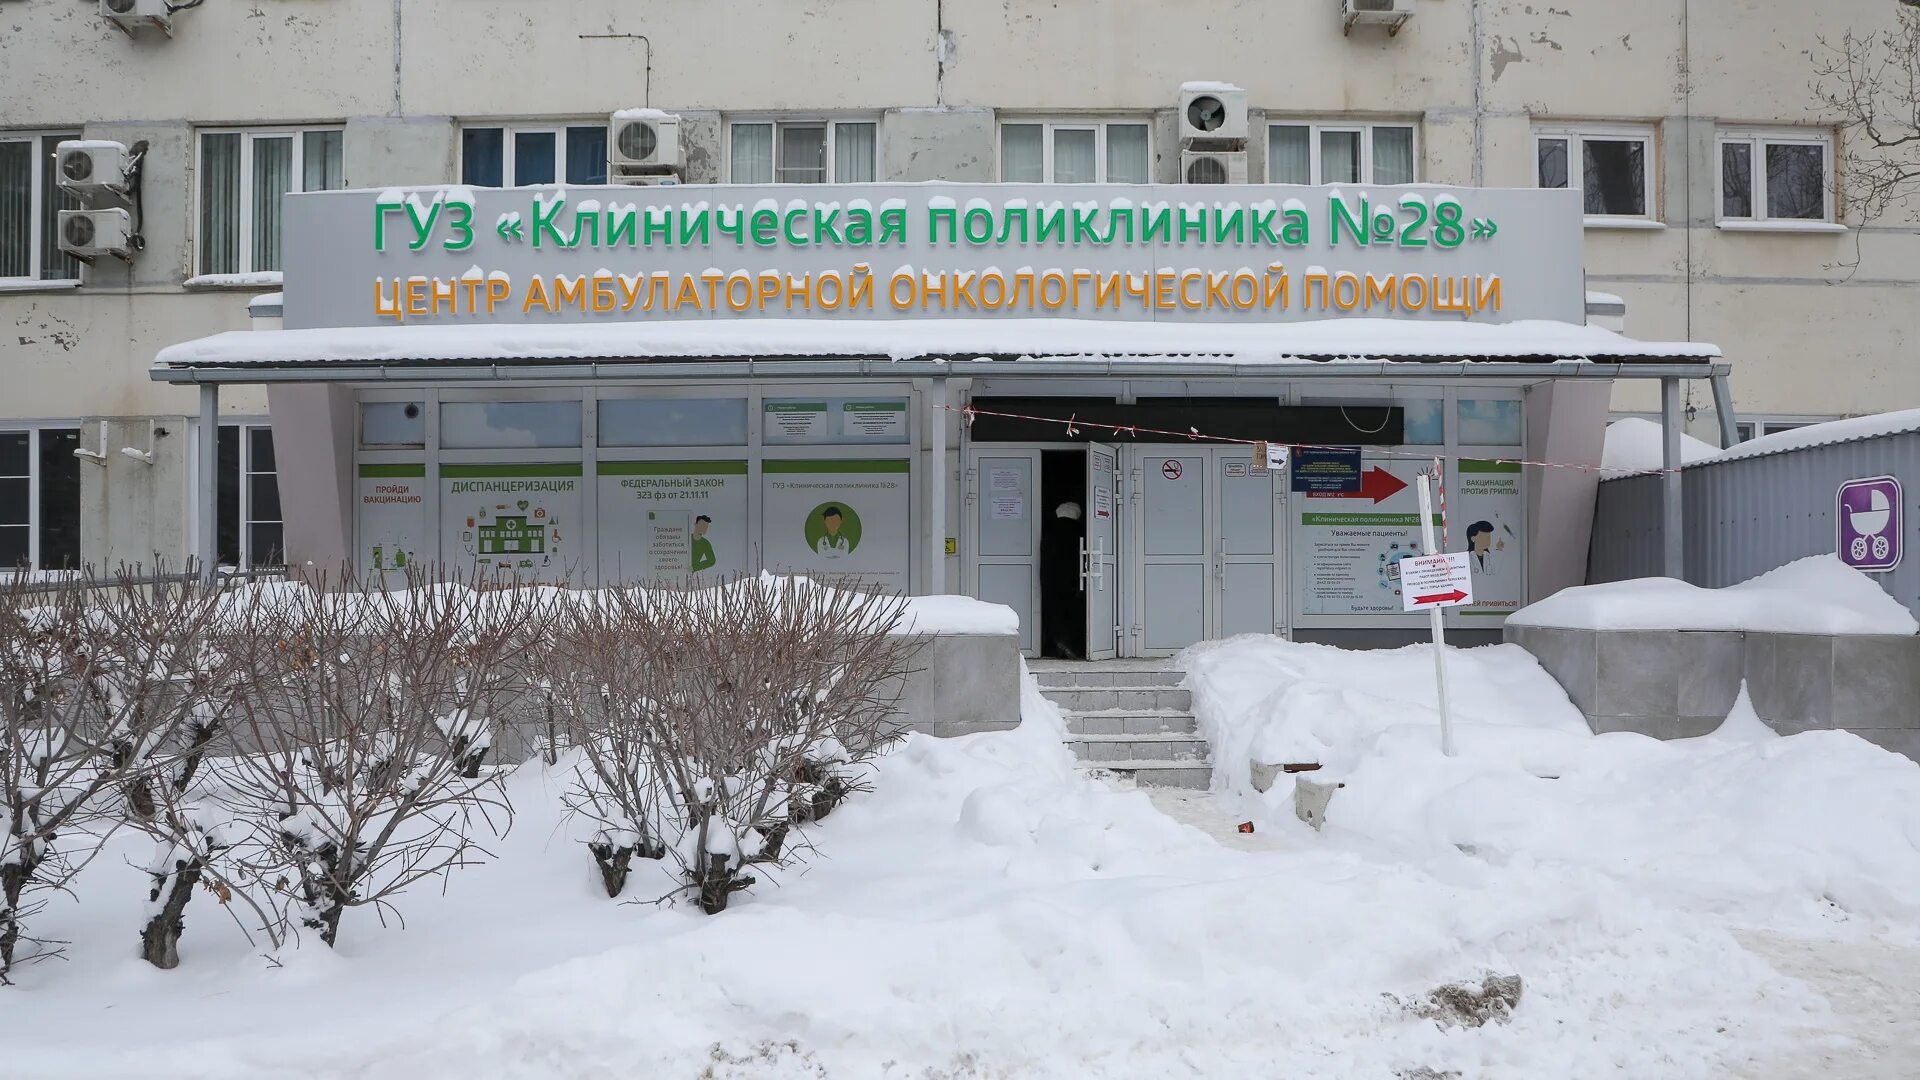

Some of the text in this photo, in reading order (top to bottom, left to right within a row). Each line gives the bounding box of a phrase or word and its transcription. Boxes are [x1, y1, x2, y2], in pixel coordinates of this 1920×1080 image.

[375, 196, 1498, 252] ГУЗ «Клиническая поликлиника №28»
[374, 265, 1502, 322] ЦЕНТР АМБУЛАТОРНОЙ ОНКОЛОГИЧЕСКОЙ ПОМОЩИ
[451, 480, 575, 493] ДИСПАНЦЕРИЗАЦИЯ
[620, 477, 725, 488] ФЕДЕРАЛЬНЫЙ ЗАКОН
[772, 482, 785, 490] ГУЗ
[835, 482, 880, 490] поликлиника
[1466, 479, 1514, 487] ВАКЦИНАЦИЯ
[376, 484, 409, 494] ПРОЙДИ
[1461, 487, 1519, 495] ПРОТИВ ГРИППА!
[363, 495, 422, 504] ВАКЦИНАЦИЮ
[637, 490, 653, 499] 323
[654, 490, 667, 501] фз
[679, 490, 709, 499] 21.11.11
[1331, 529, 1408, 538] Уважаемые пациенты!
[1351, 604, 1369, 612] Будьте
